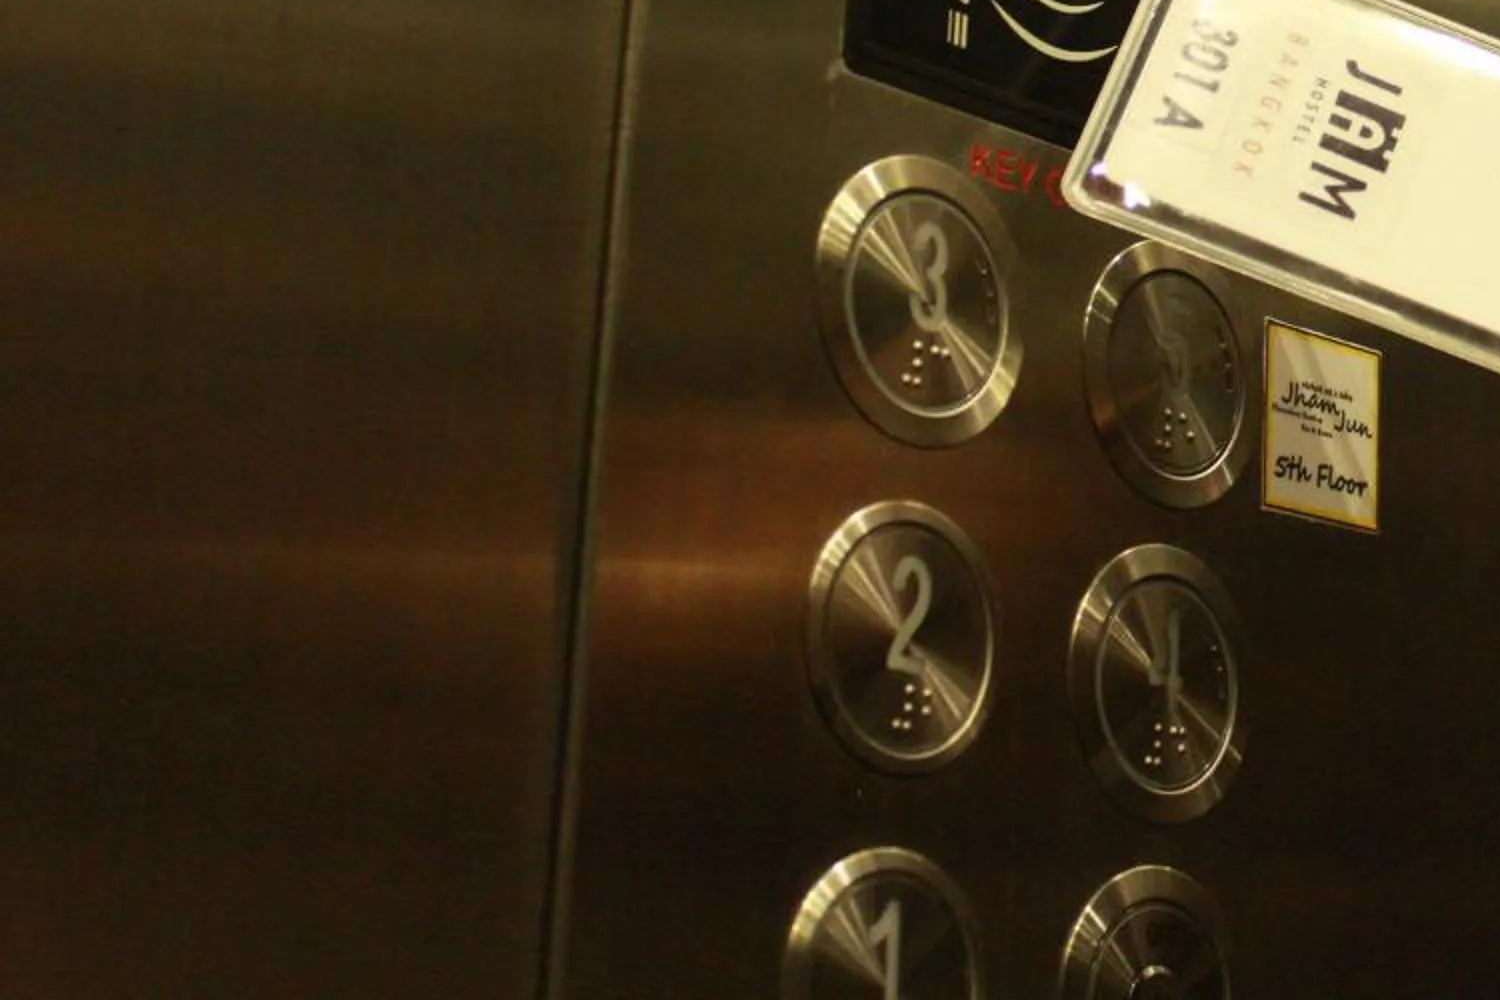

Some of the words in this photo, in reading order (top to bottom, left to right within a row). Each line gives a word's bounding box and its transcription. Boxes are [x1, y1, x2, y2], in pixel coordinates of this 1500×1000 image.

[1152, 95, 1205, 131] A
[1232, 31, 1310, 178] BANGKOK
[1291, 76, 1330, 144] HOSTEL
[1298, 59, 1407, 221] JAM
[968, 143, 1042, 195] KEY
[909, 220, 948, 332] 3
[1281, 380, 1340, 416] Jham
[1333, 409, 1373, 439] Jun
[1274, 455, 1312, 484] 5th
[1316, 464, 1369, 497] Floor
[886, 554, 933, 676] 2
[868, 899, 901, 1000] 1
